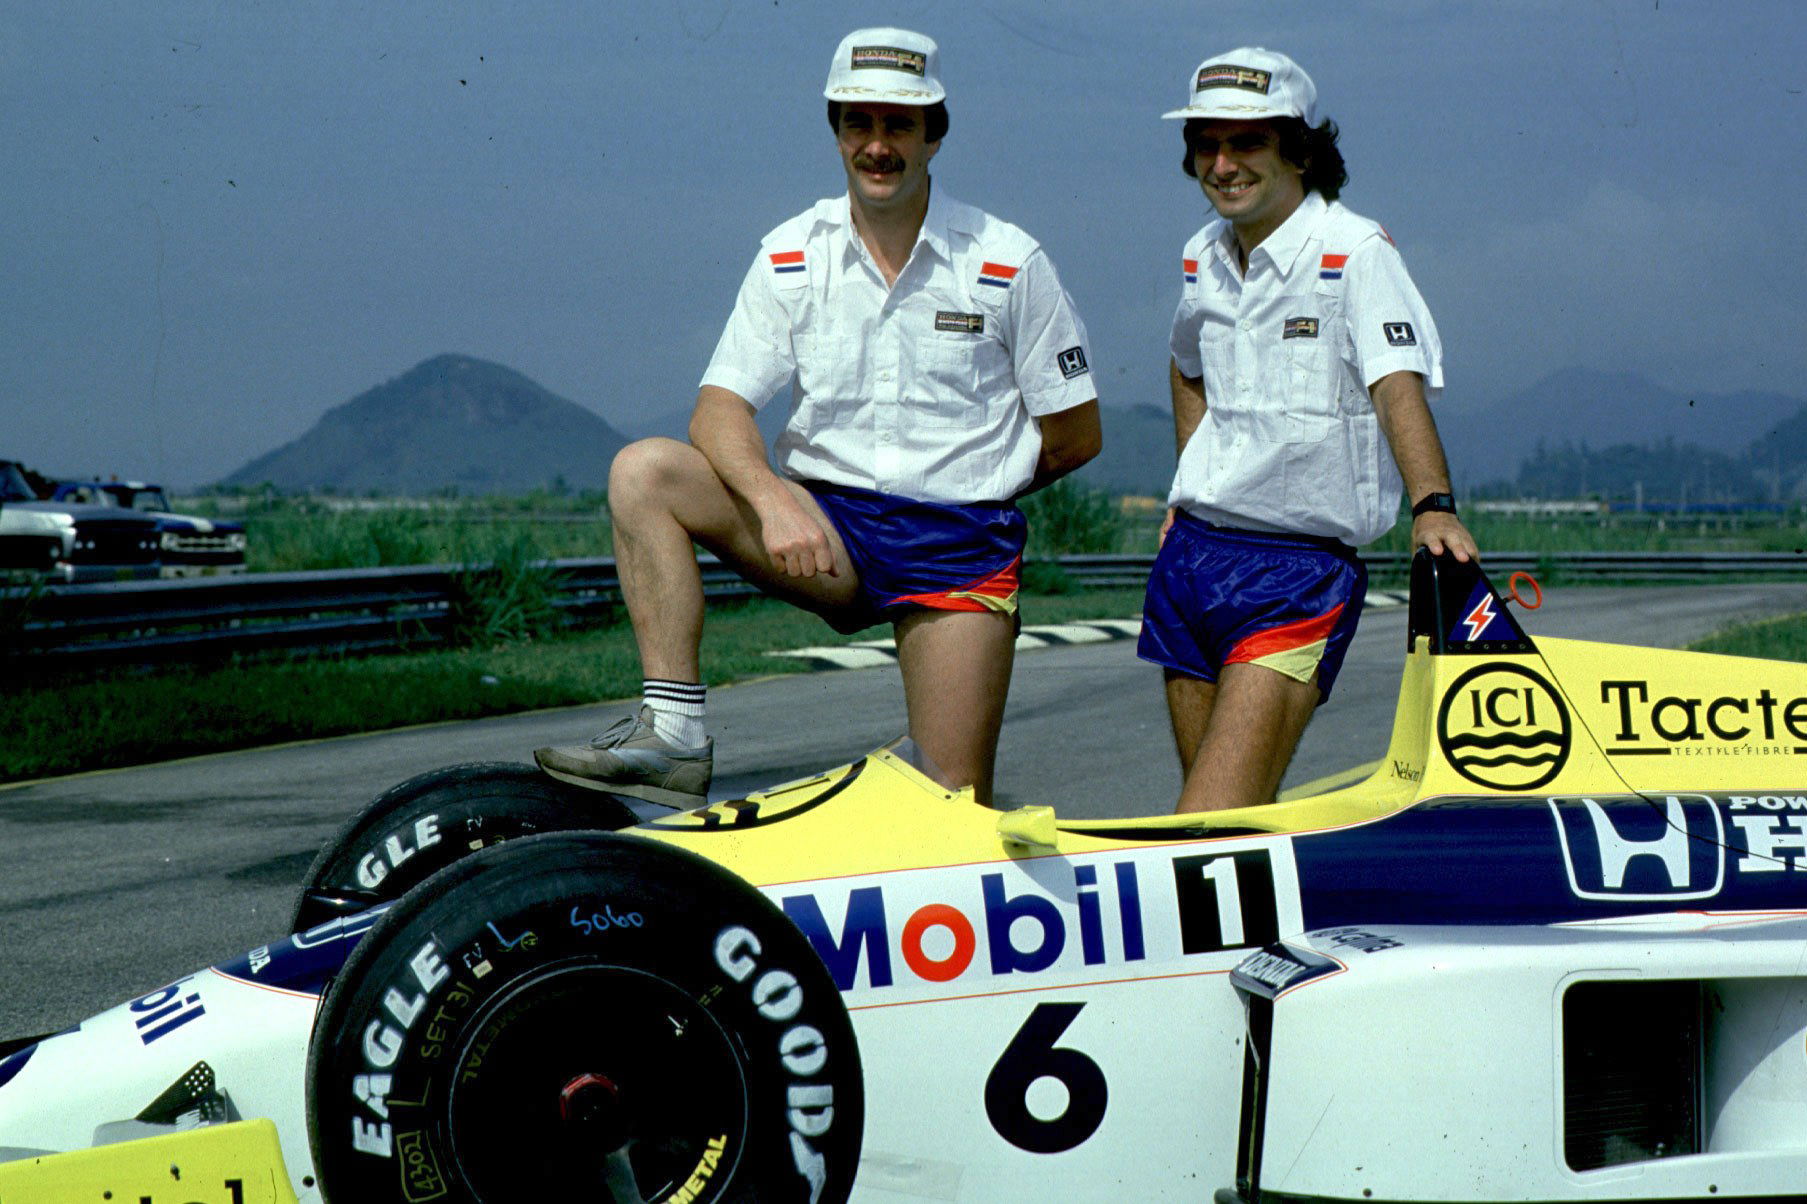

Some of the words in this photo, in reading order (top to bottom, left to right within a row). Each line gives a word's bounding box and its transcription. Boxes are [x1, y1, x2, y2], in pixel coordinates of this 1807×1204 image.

[1470, 687, 1537, 728] ICI
[1675, 746, 1740, 755] TEXTILE
[1746, 746, 1790, 755] FIBRE
[781, 861, 1146, 992] Mobil
[1202, 856, 1245, 947] 1
[352, 941, 452, 1158] EAGLE
[984, 1001, 1108, 1154] 6
